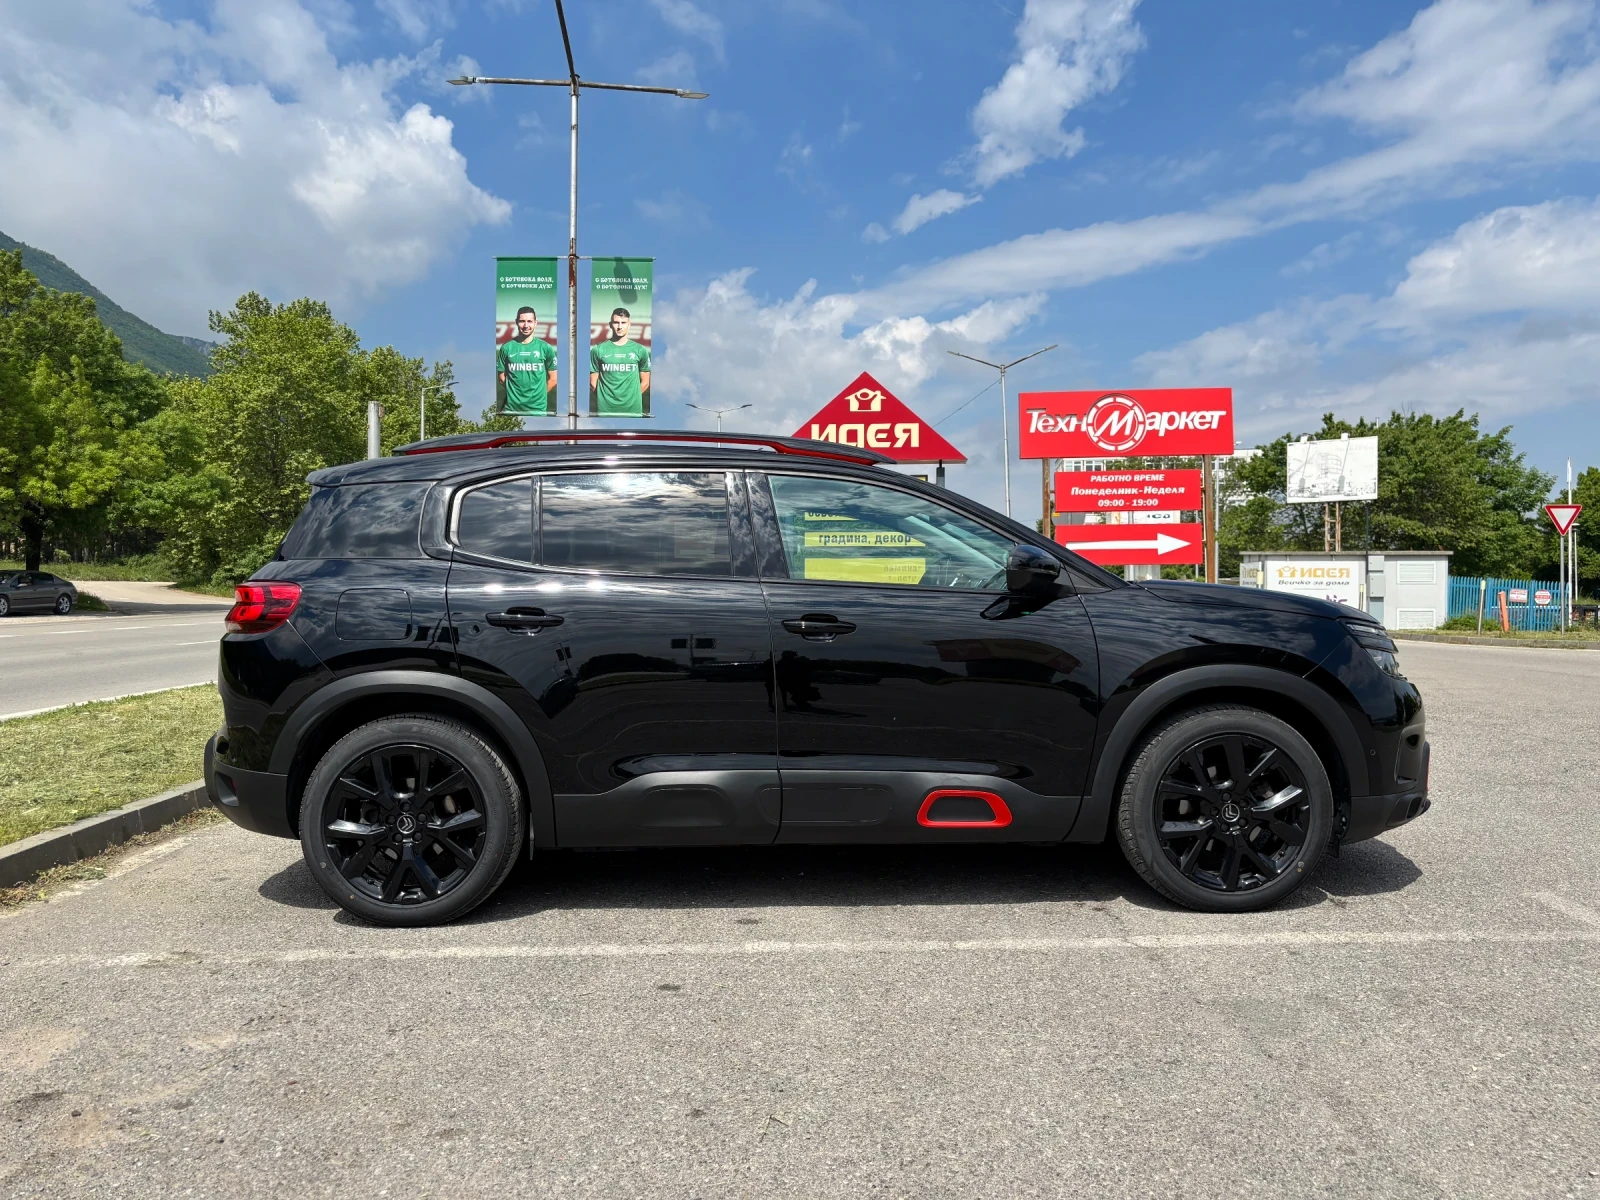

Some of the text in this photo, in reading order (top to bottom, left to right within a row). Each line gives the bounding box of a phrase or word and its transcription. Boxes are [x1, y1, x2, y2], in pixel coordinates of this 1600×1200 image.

[508, 362, 544, 371] WINBET
[602, 363, 637, 372] WINBET
[811, 422, 920, 448] ИДЕЯ
[1090, 474, 1165, 483] РАБОТНО ВРЕМЕ
[1098, 499, 1125, 507] 09:00
[1131, 498, 1159, 507] 19:00
[818, 534, 912, 546] градина, декор
[1300, 567, 1350, 578] ИДЕЯ
